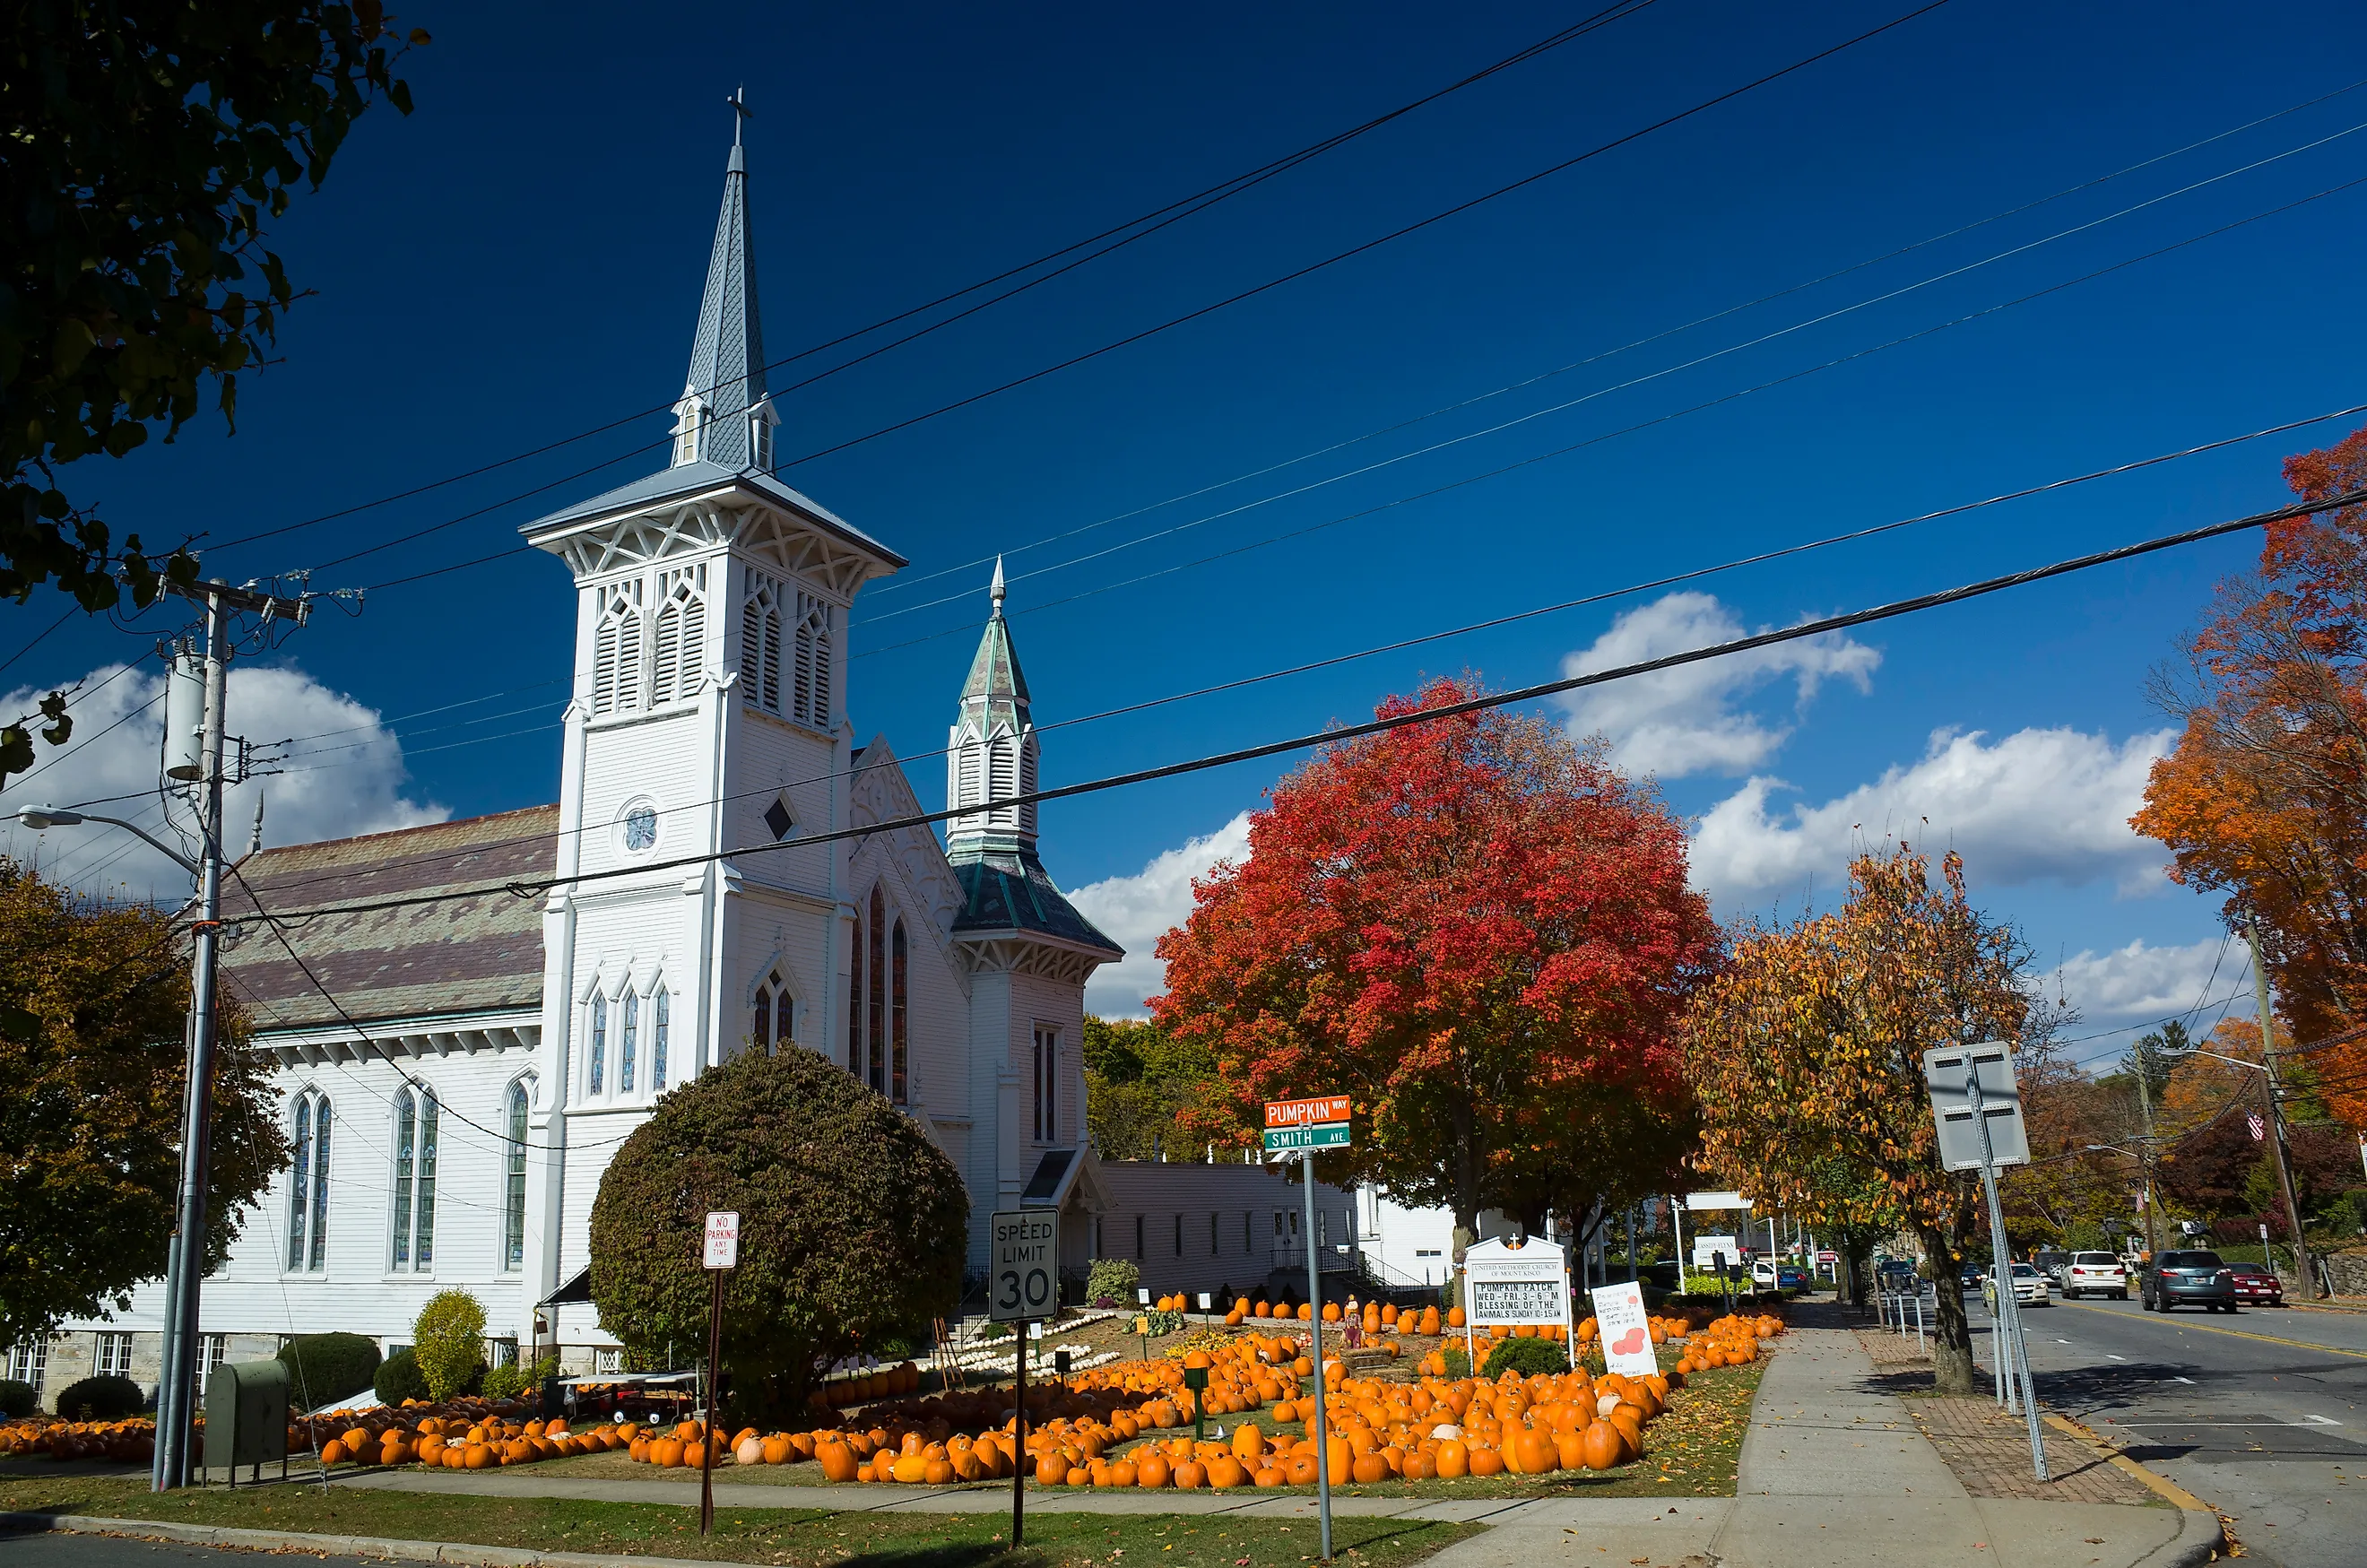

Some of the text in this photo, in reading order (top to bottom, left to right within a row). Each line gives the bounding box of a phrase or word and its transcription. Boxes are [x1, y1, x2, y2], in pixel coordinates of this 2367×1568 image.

[1268, 1099, 1347, 1123] PUMPKIN WAY
[1271, 1131, 1346, 1147] SMITH AVE.
[715, 1217, 728, 1228] NO
[707, 1229, 735, 1240] PARKING
[997, 1223, 1053, 1242] SPEED
[1002, 1245, 1045, 1263] LIMIT
[998, 1268, 1049, 1310] 30
[1480, 1283, 1553, 1292] PUMPKIN PATCH
[1477, 1292, 1495, 1301] WED
[1478, 1301, 1555, 1310] BLESSING OF THE
[1478, 1310, 1510, 1319] ANIMALS
[1512, 1310, 1532, 1318] SUNDAY
[1535, 1310, 1553, 1318] 10:15
